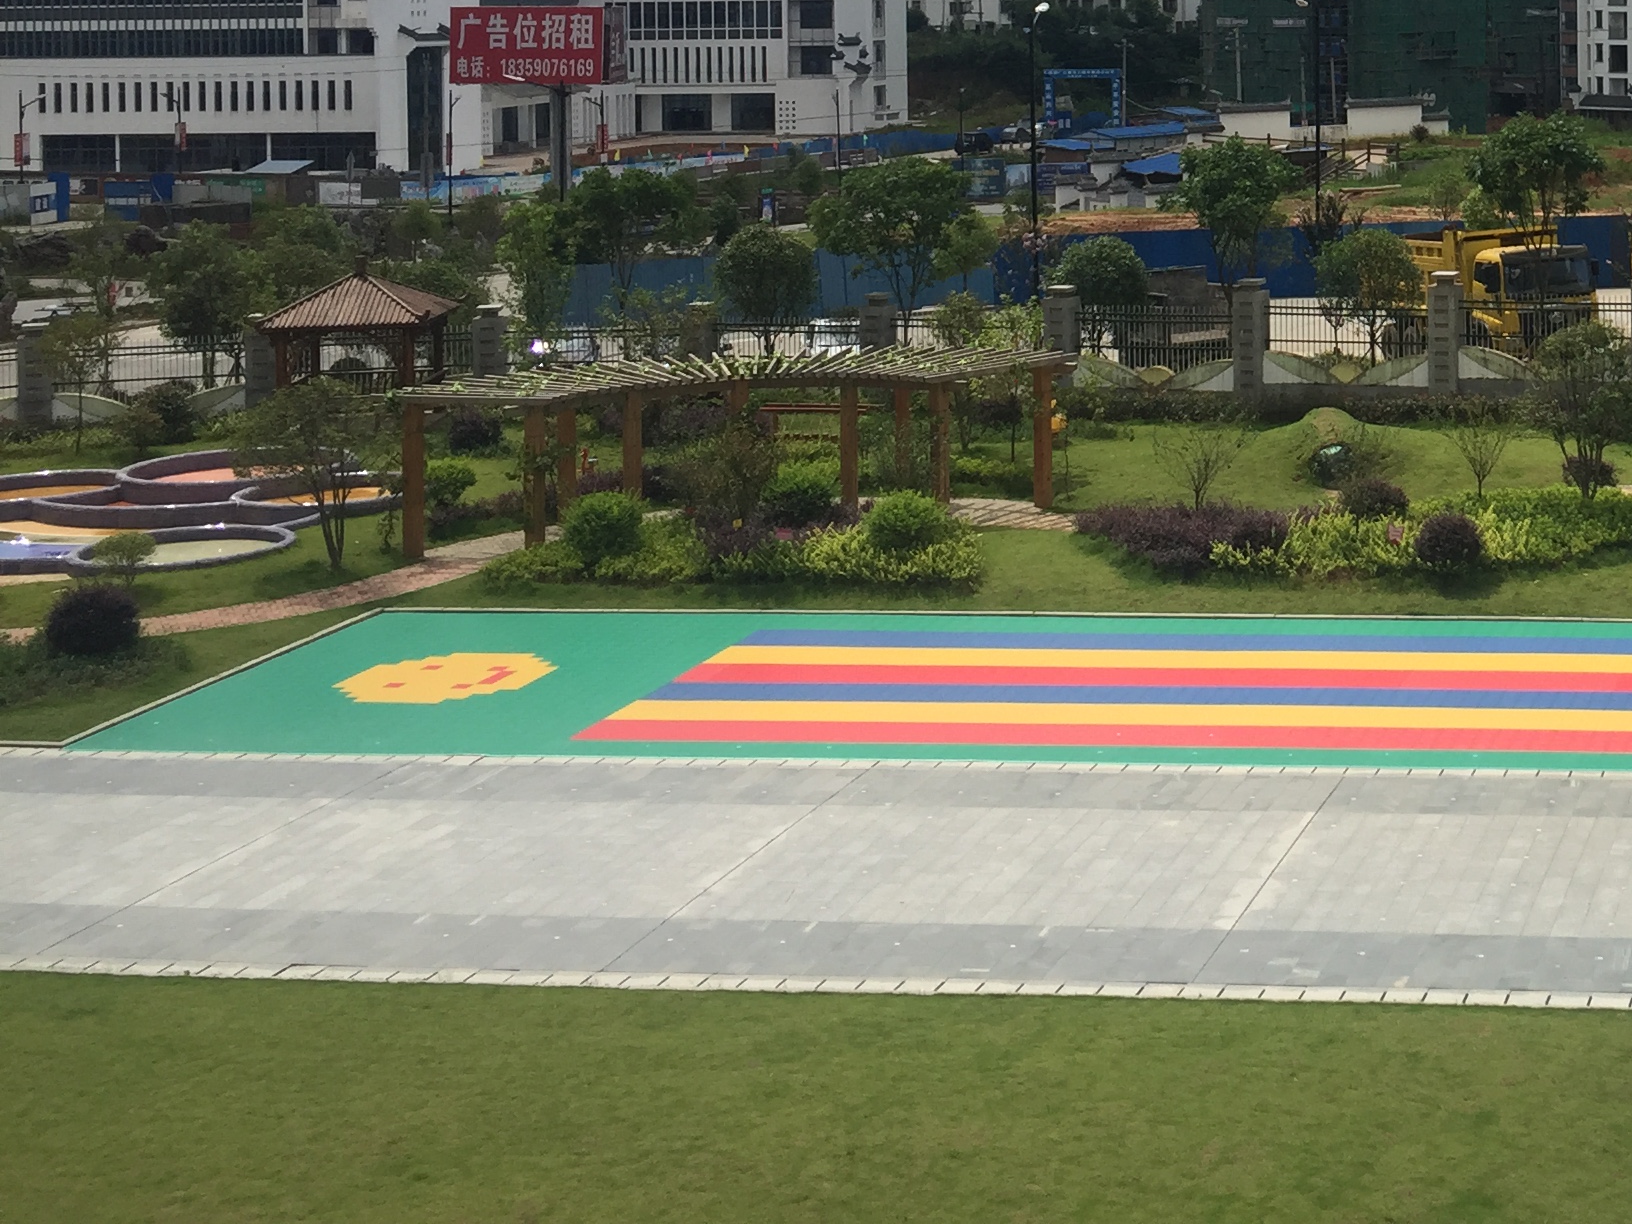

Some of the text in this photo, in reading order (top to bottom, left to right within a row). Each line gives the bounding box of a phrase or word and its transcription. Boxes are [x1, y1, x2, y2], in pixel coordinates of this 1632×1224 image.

[457, 13, 595, 50] 广告位招租
[500, 58, 594, 77] 18359076169
